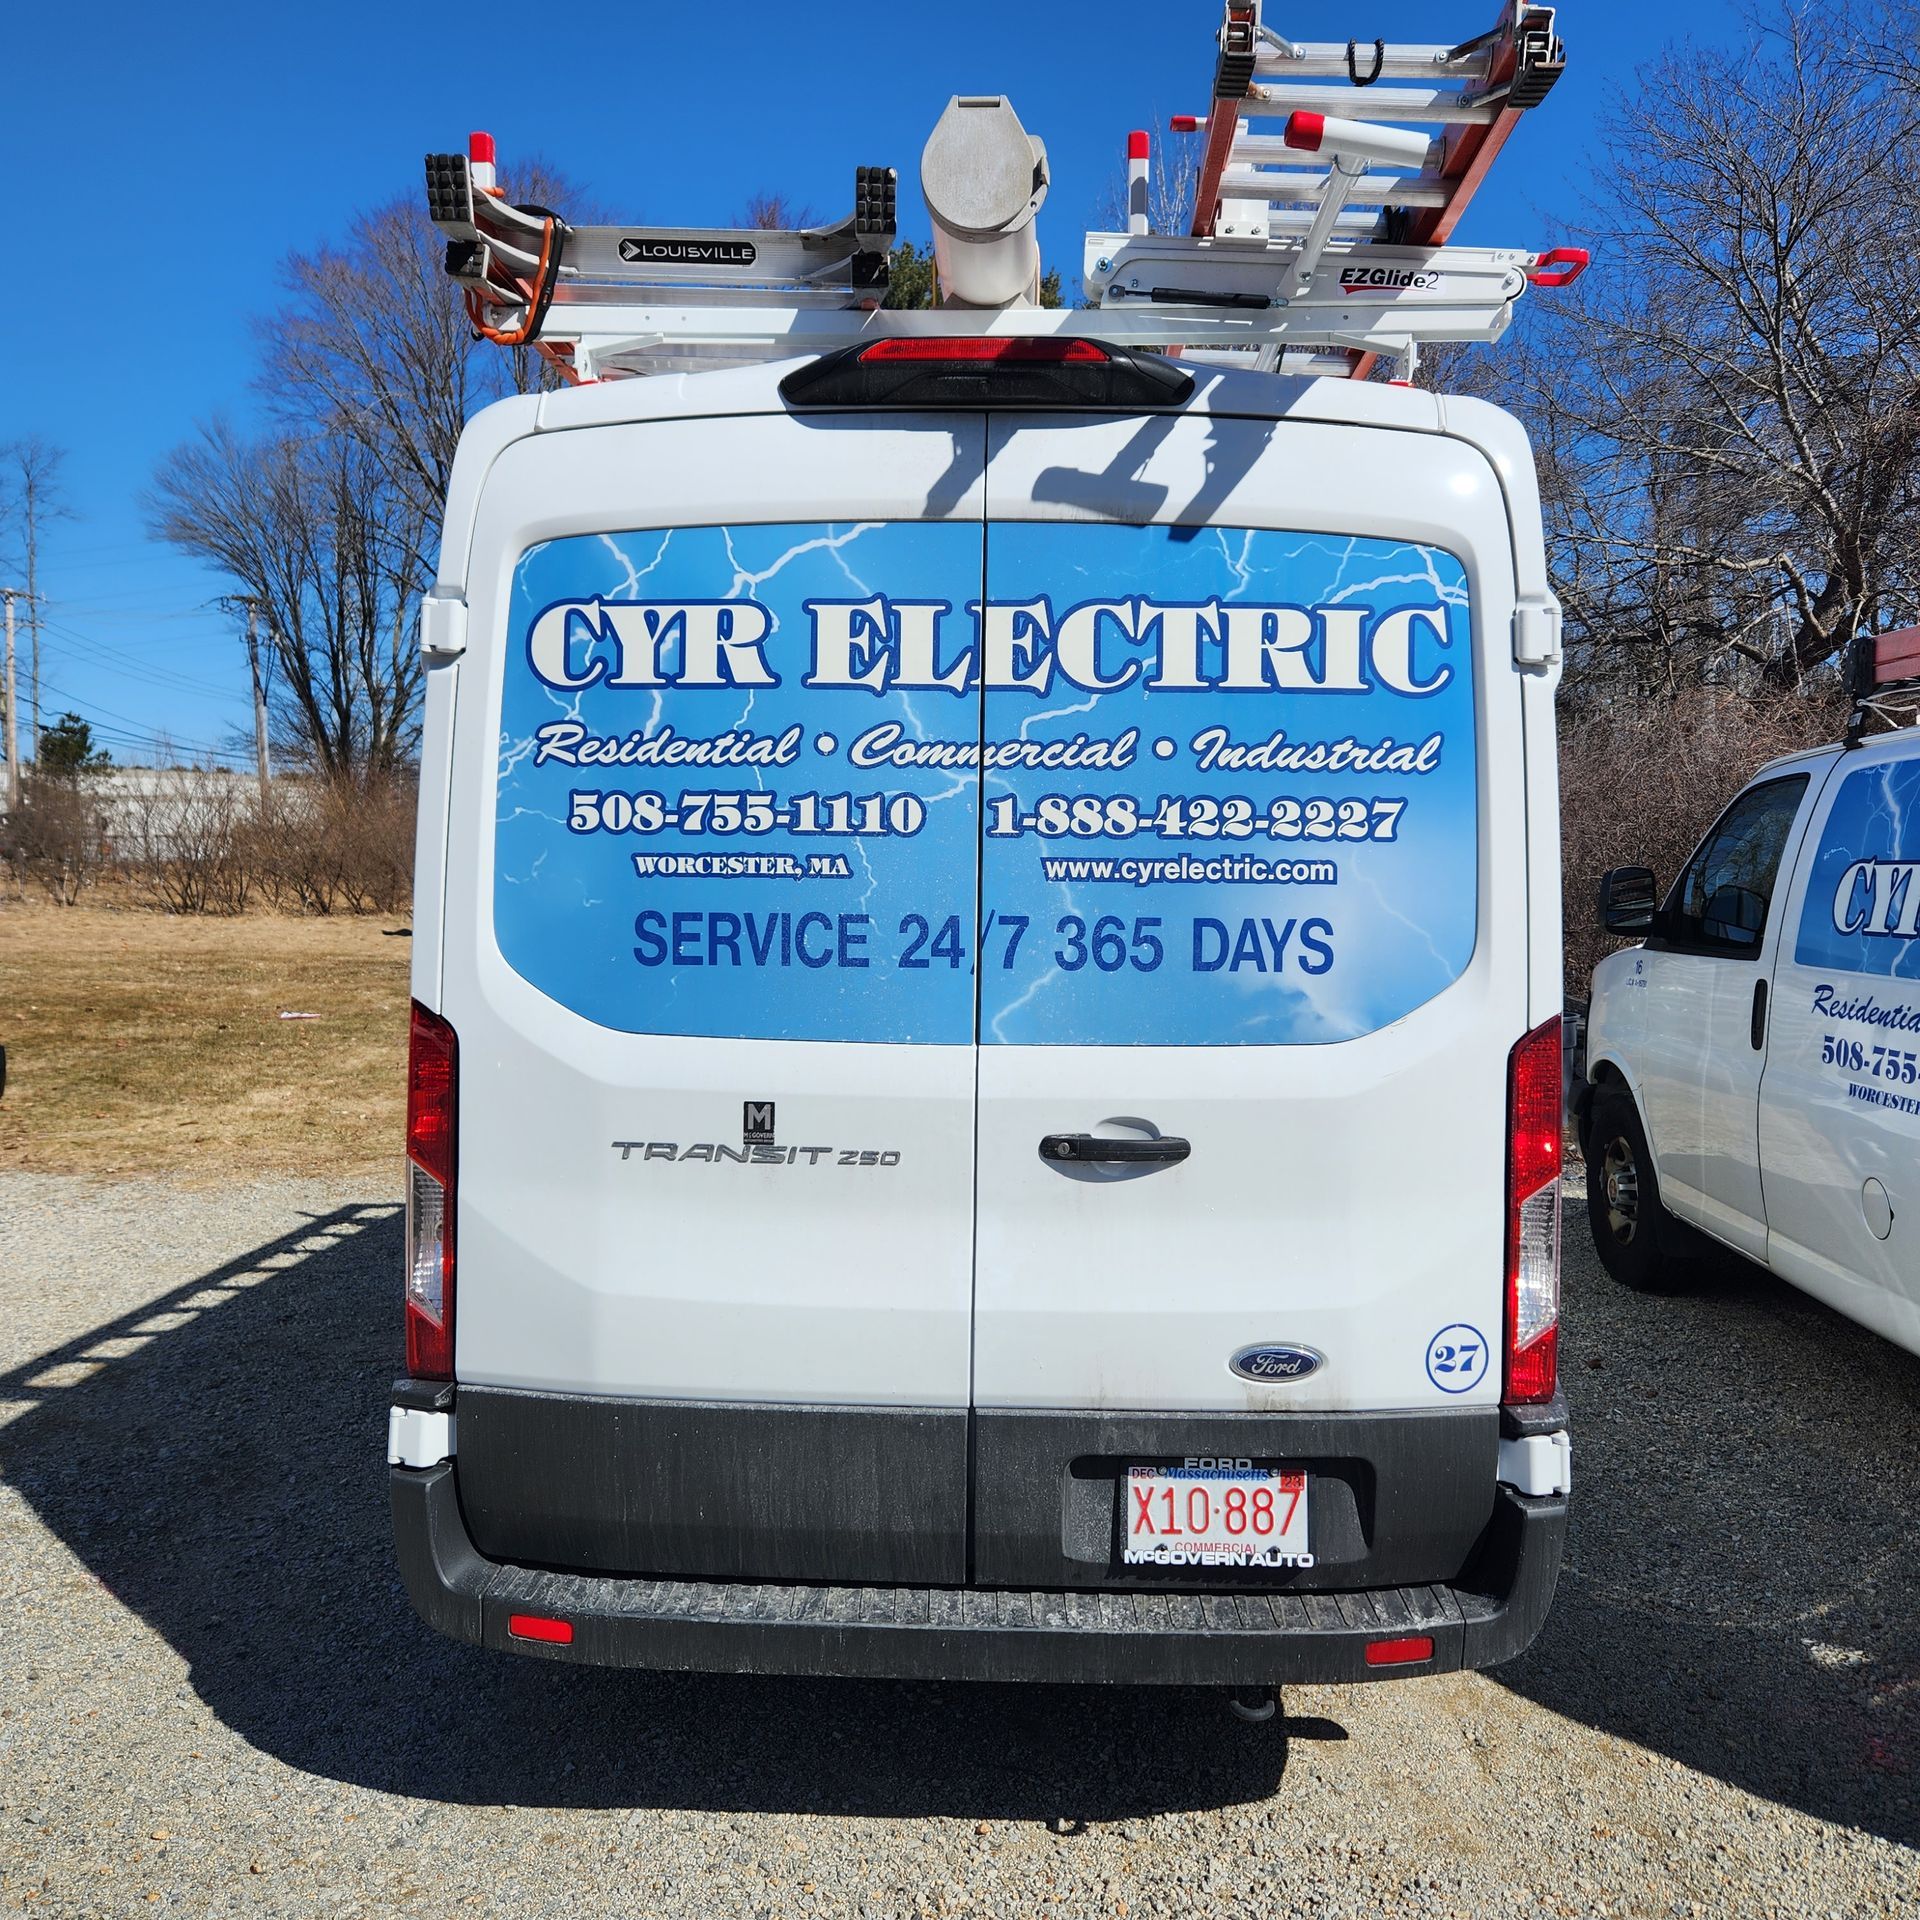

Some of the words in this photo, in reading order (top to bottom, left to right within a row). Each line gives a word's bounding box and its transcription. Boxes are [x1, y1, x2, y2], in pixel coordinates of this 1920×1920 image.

[642, 245, 753, 259] LOUISVILLE
[526, 592, 781, 692] CYR
[801, 593, 1454, 698] ELECTRIC
[533, 719, 804, 769] Residential
[846, 719, 1140, 772] Commercial
[1189, 725, 1445, 775] Industrial
[567, 788, 928, 838] 508-755-1110
[986, 791, 1409, 843] 1-888-422-2227
[632, 851, 804, 882] WORCESTER,
[806, 853, 854, 880] MA
[1041, 852, 1339, 887] www.cyrelectric.com
[633, 909, 871, 970] SERVICE
[897, 909, 1031, 977] 24/7
[1054, 914, 1165, 974] 365
[1192, 916, 1336, 976] DAYS
[1634, 959, 1645, 976] 16
[747, 1103, 772, 1131] M
[610, 1140, 833, 1166] TRANSIT
[836, 1149, 901, 1167] 250
[1251, 1353, 1302, 1375] Ford
[1434, 1344, 1480, 1374] 27
[1132, 1467, 1155, 1480] DEC
[1164, 1466, 1269, 1482] Massachusetts
[1183, 1456, 1253, 1471] FORD
[1283, 1475, 1303, 1489] 23
[1123, 1549, 1248, 1567] McGOVERN
[1249, 1551, 1315, 1569] AUTO
